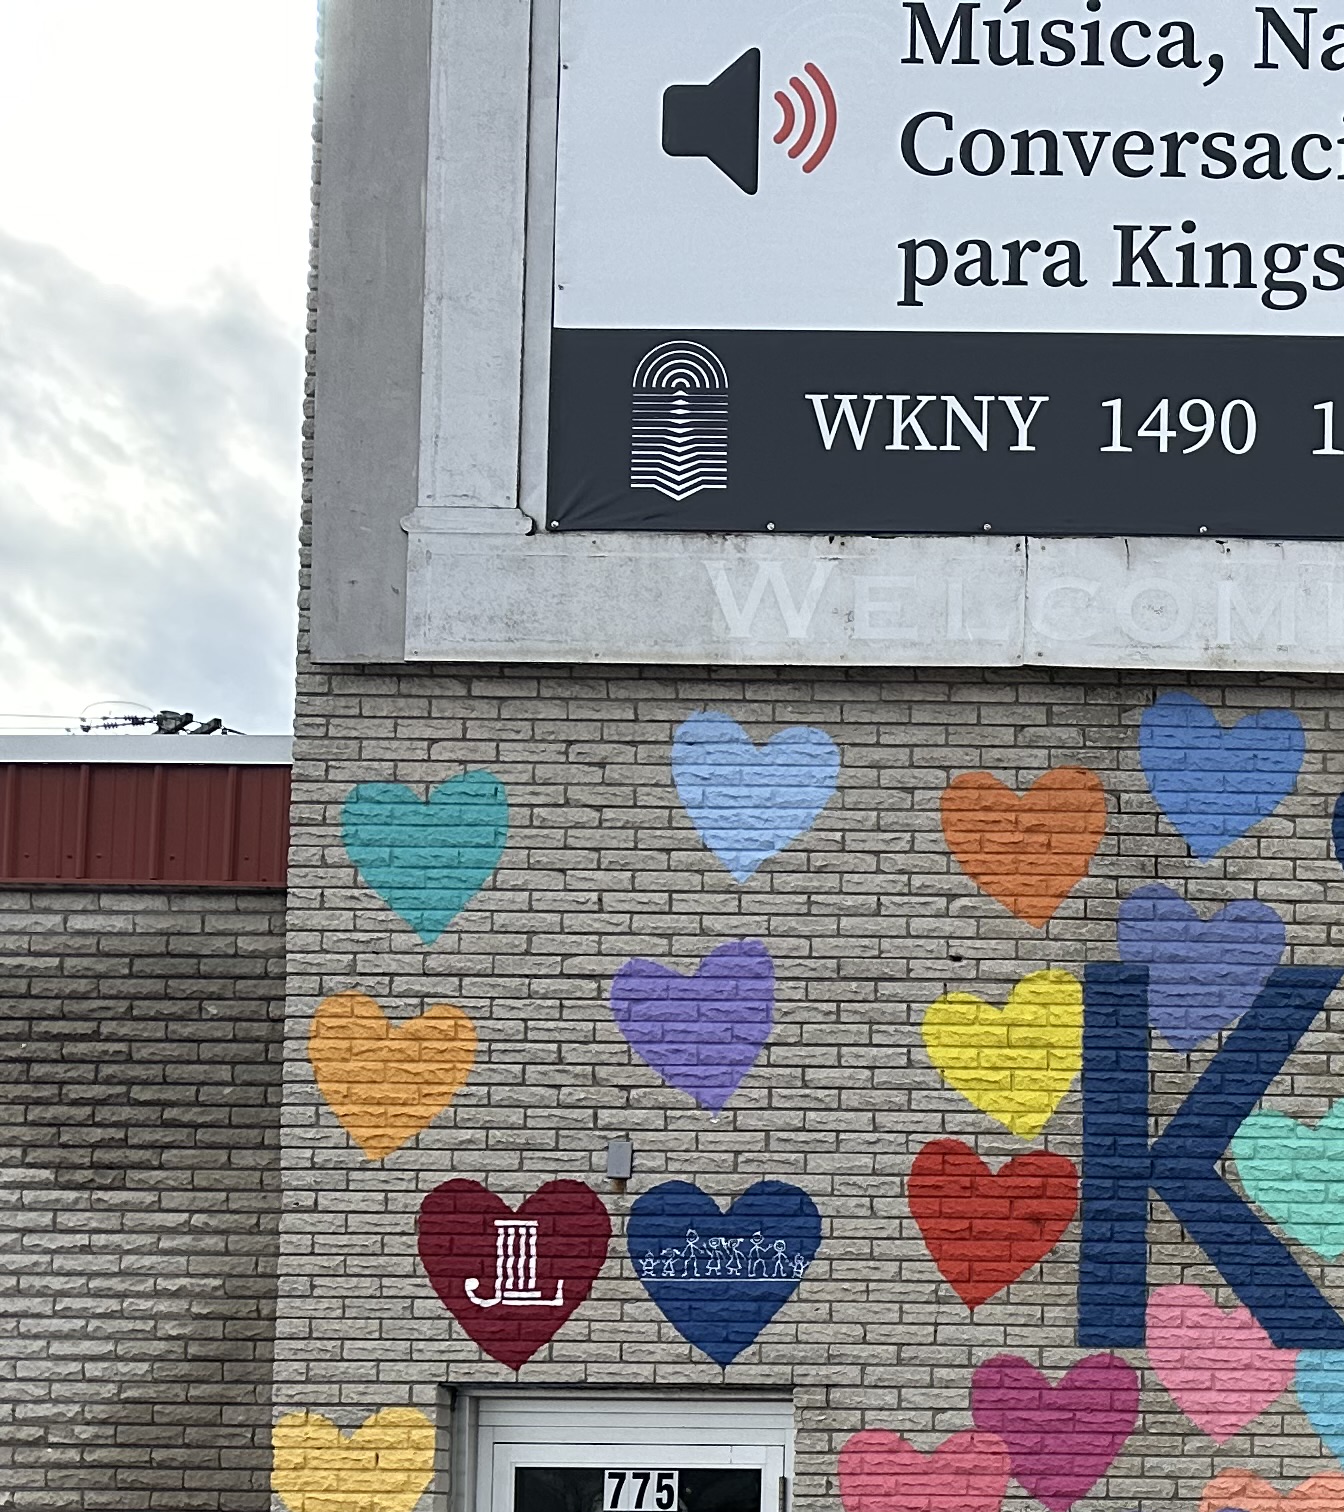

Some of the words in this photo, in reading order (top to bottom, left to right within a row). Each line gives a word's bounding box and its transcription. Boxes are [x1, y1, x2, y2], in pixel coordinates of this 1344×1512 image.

[901, 0, 1223, 87] Música,
[896, 238, 1088, 307] para
[805, 394, 1049, 452] WKNY
[1101, 398, 1257, 454] 1490
[607, 1471, 675, 1510] 775
